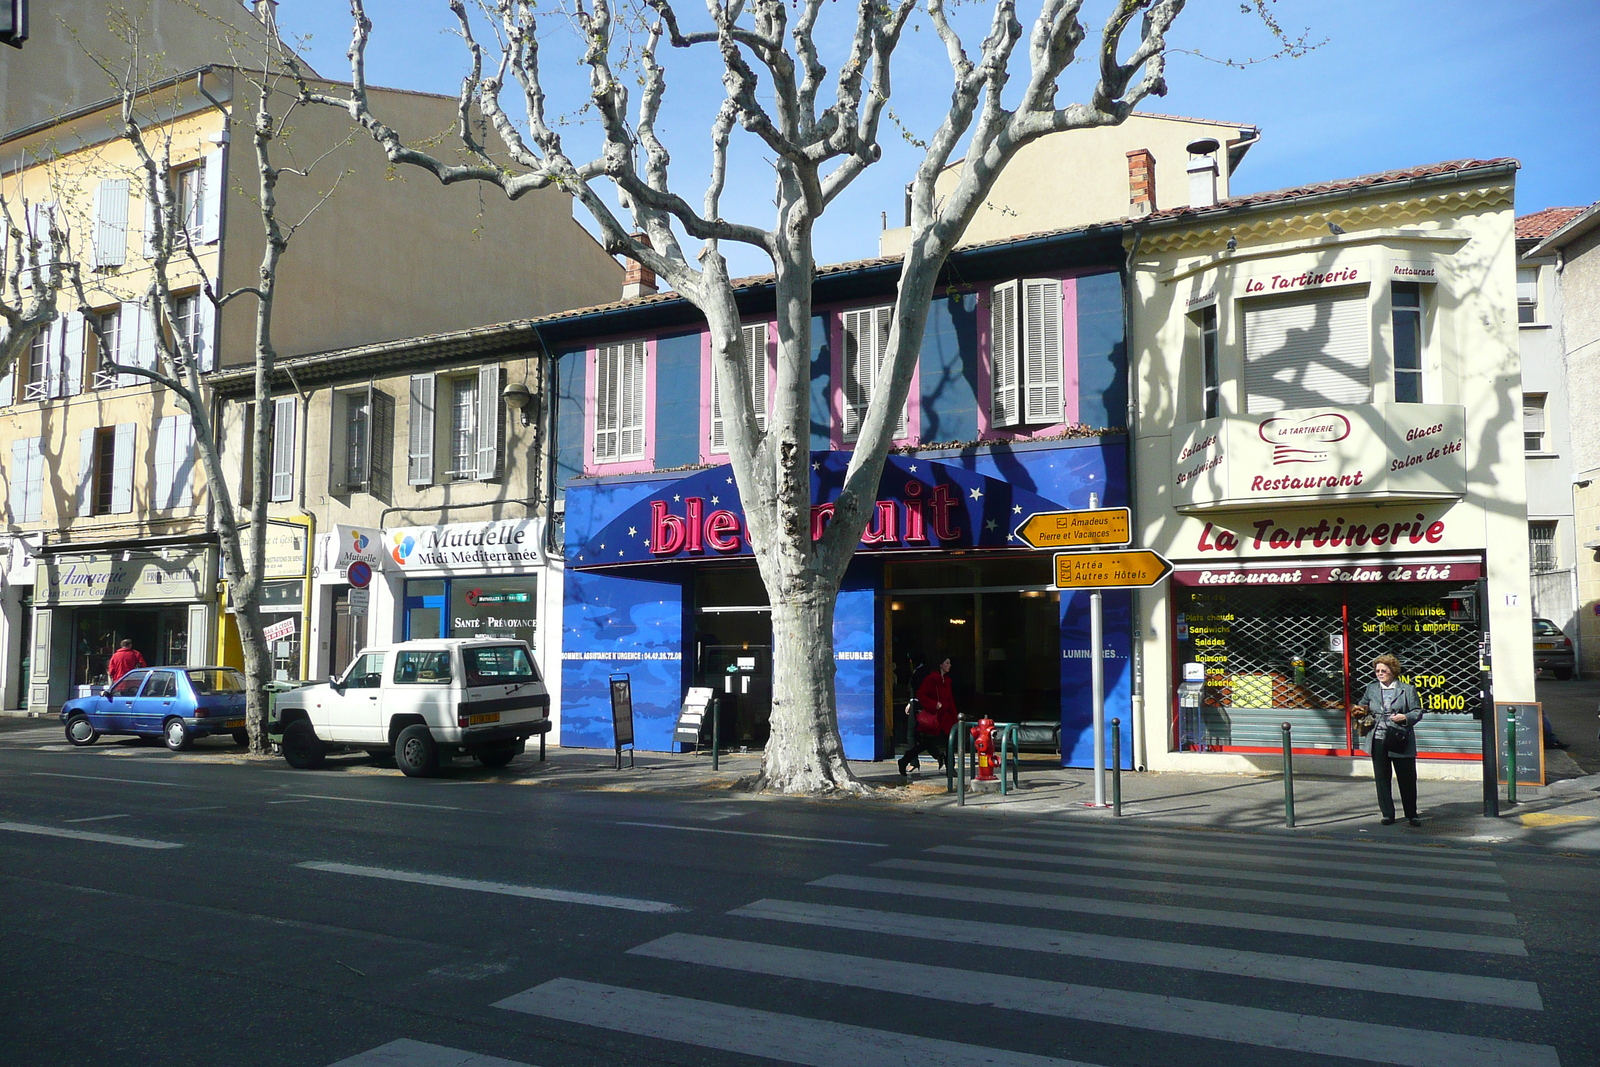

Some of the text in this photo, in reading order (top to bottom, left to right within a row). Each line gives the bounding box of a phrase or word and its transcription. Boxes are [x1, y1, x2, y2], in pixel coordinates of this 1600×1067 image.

[1394, 265, 1435, 277] Restaurant
[1245, 267, 1358, 293] La Tartinerie
[1290, 425, 1334, 434] TARTINERIE
[1406, 423, 1443, 442] Glaces
[1181, 435, 1217, 460] Salades
[1390, 438, 1462, 472] Salon de thé
[1176, 455, 1223, 485] Sandwichs
[1251, 470, 1363, 492] Restaurant
[650, 496, 753, 554] ble
[1070, 517, 1109, 527] Amadeus
[427, 525, 525, 549] Mutuelle
[1039, 530, 1110, 541] Pierre et Vacances
[1197, 513, 1445, 552] La Tartinerie
[344, 552, 377, 562] Mutuelle
[418, 549, 537, 564] Midi Méditerranée
[1074, 560, 1103, 570] Artéa
[51, 565, 127, 587] Armurerie
[1074, 570, 1147, 581] Autres Hôtels
[1198, 569, 1302, 585] Restaurant
[1327, 567, 1384, 582] Salon
[1387, 566, 1412, 580] de
[1416, 564, 1451, 580] thé
[42, 585, 136, 598] Chasse Tir Coutellerie
[1505, 594, 1518, 606] 17
[1206, 613, 1235, 621] chauds
[1376, 605, 1399, 617] Salle
[1189, 626, 1231, 634] Sandwichs
[1362, 622, 1376, 632] Sur
[1379, 622, 1399, 635] place
[1402, 624, 1412, 632] ou
[1422, 621, 1460, 635] emporter
[1195, 638, 1226, 646] Salades
[1415, 675, 1446, 688] STOP
[1428, 694, 1465, 709] 18h00
